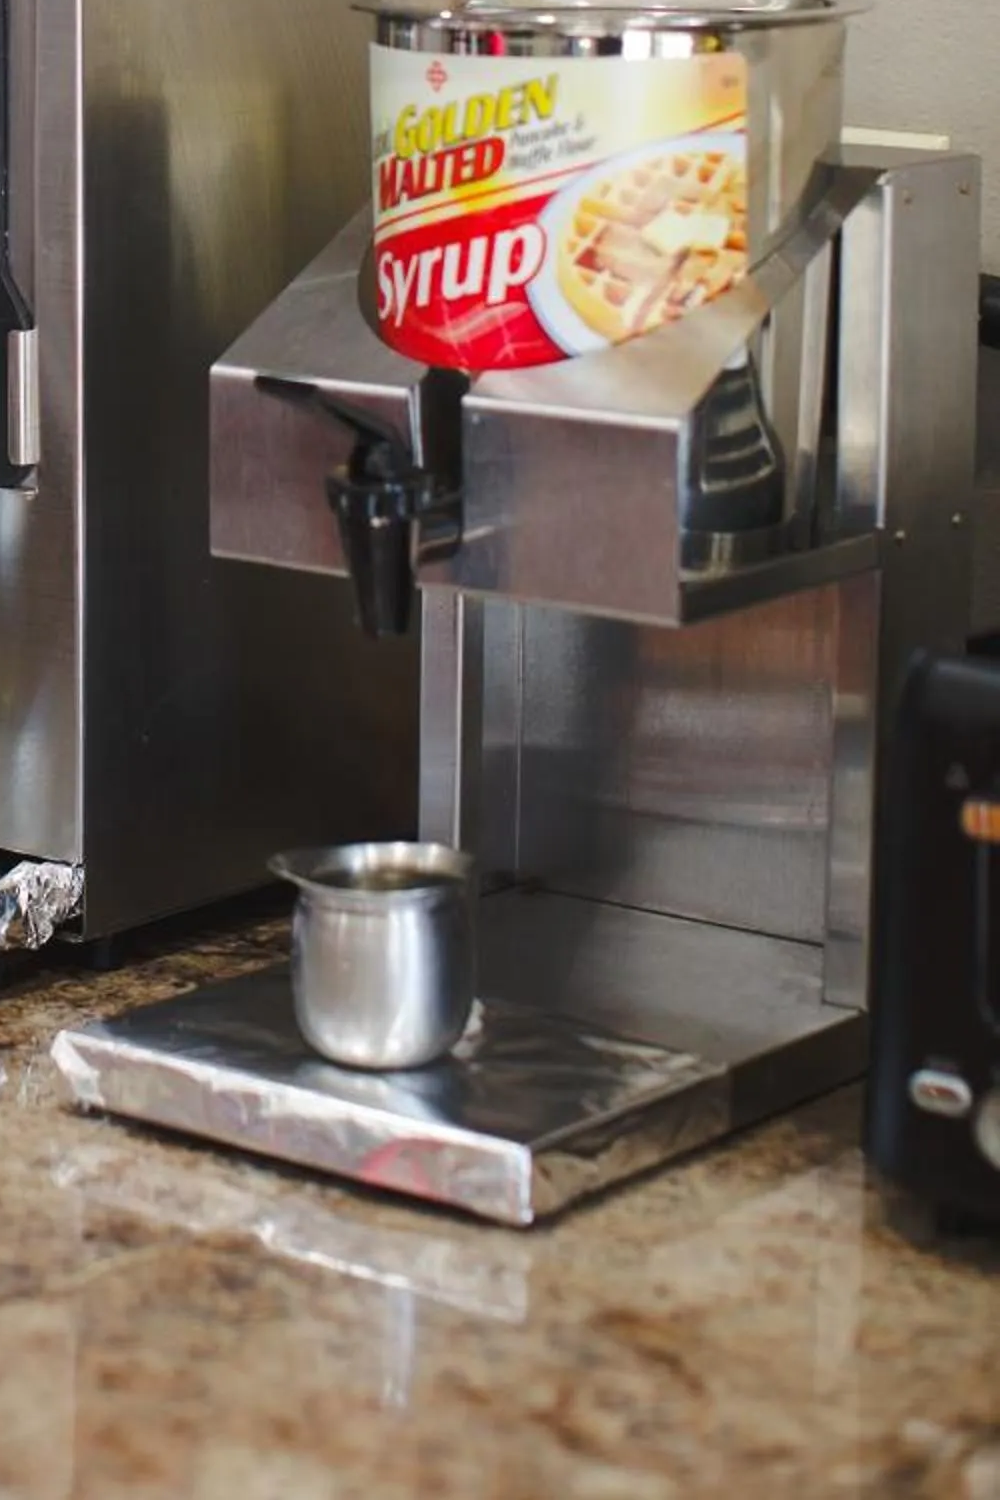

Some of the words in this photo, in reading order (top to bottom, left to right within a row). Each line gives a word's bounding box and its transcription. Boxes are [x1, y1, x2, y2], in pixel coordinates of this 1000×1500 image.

[393, 72, 559, 160] GOLDEN
[378, 136, 505, 213] MALTED
[377, 221, 546, 328] Syrup
